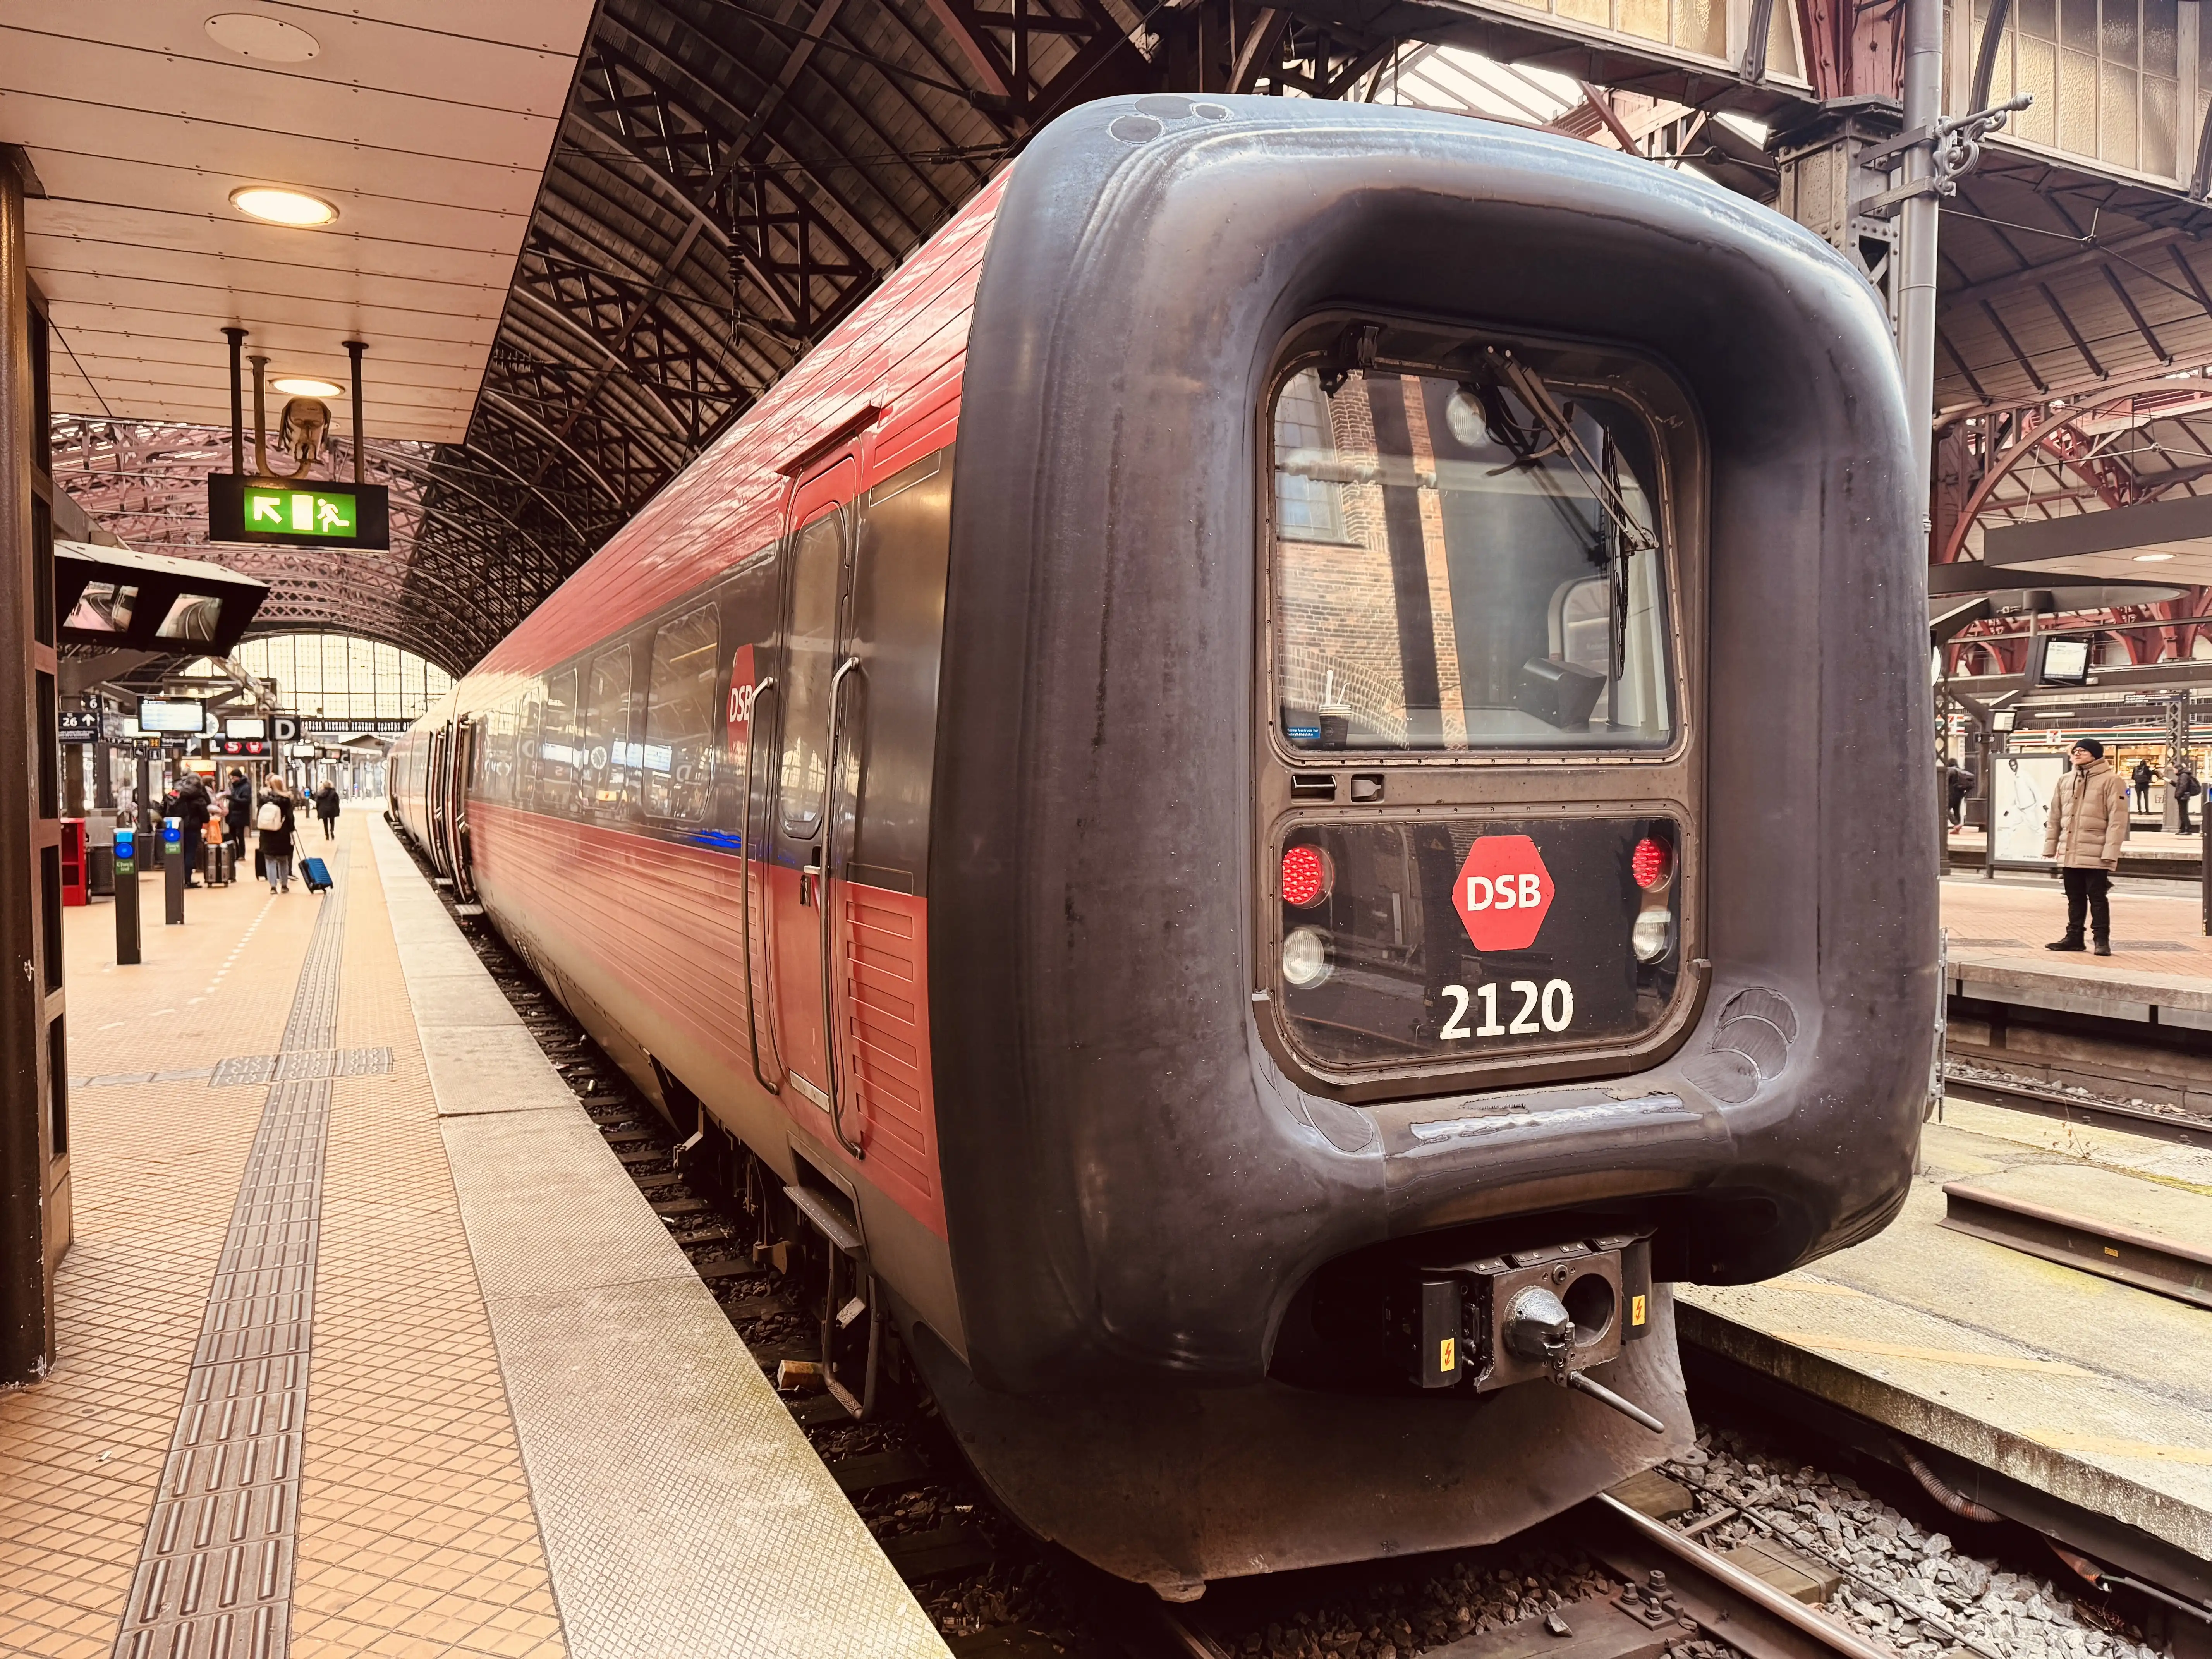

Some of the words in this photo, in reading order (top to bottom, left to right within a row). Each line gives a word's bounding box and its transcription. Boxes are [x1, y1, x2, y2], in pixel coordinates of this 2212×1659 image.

[63, 717, 77, 727] 26
[730, 685, 752, 722] DSB
[275, 719, 295, 740] D
[1467, 874, 1542, 912] DSB
[1439, 978, 1573, 1040] 2120
